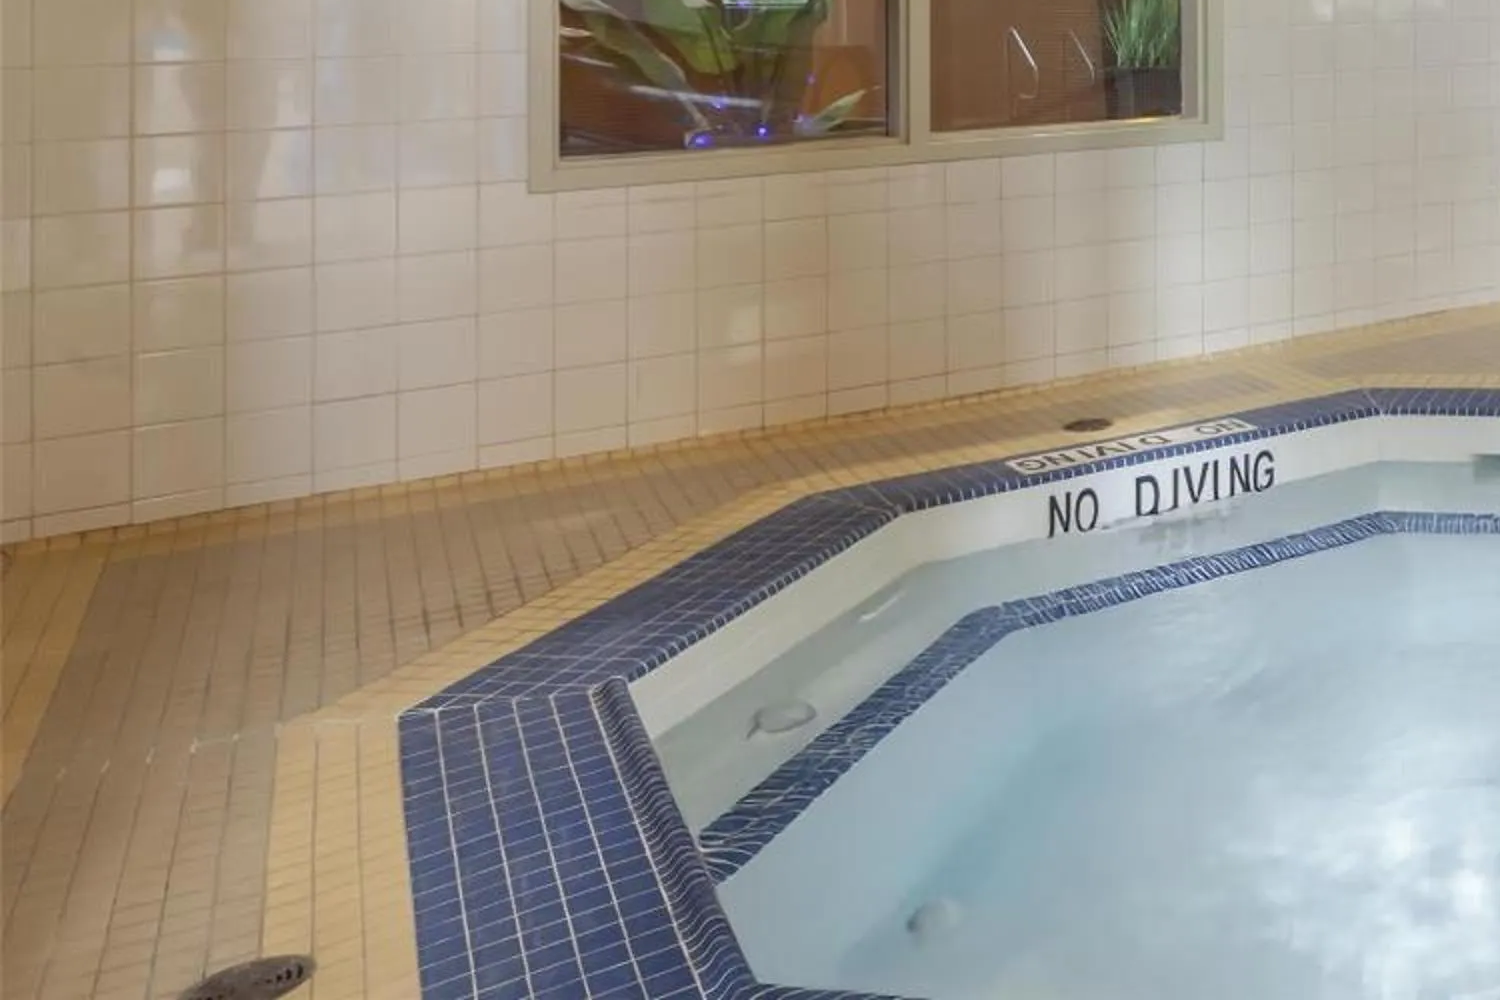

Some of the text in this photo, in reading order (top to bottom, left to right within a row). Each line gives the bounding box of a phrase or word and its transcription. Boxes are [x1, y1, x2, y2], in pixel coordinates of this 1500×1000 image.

[1016, 418, 1246, 470] NO DIVING
[1047, 450, 1275, 540] NO DIVING
